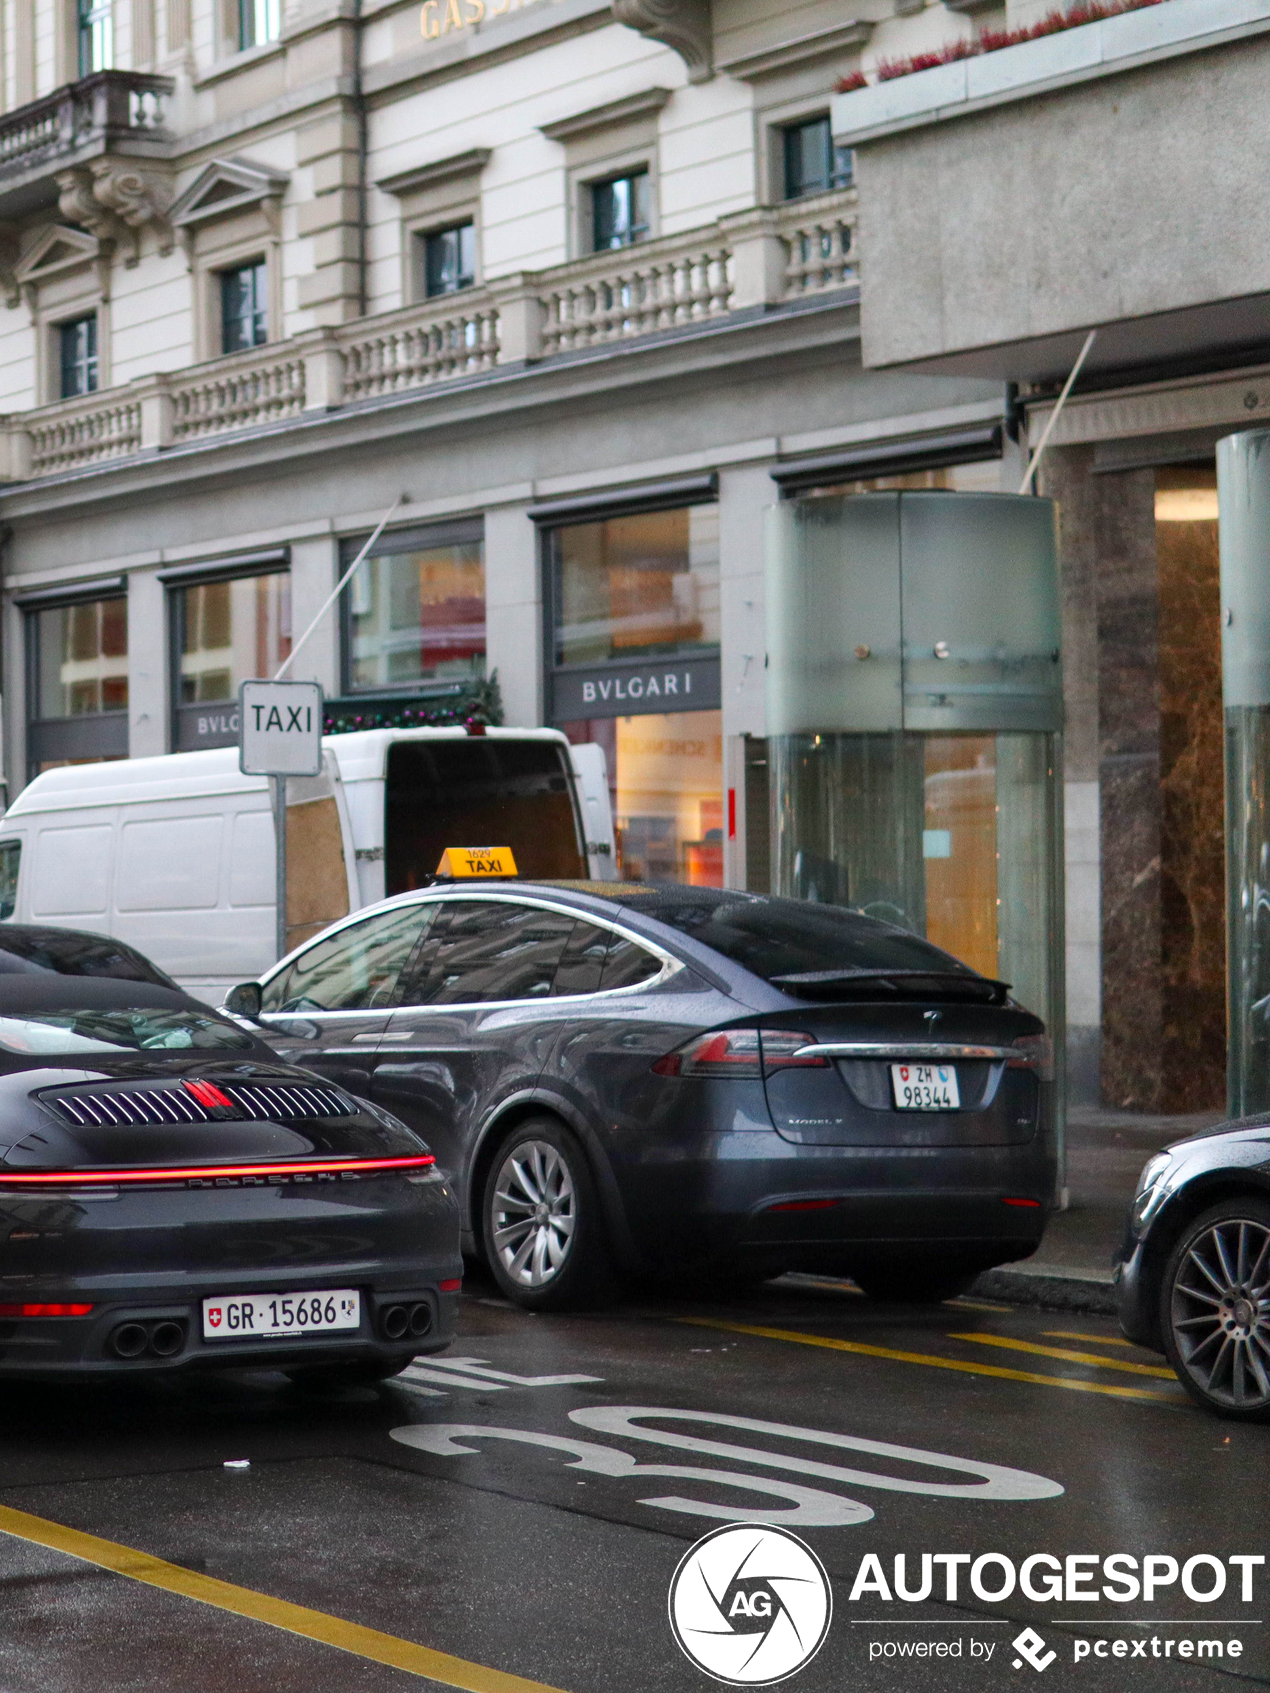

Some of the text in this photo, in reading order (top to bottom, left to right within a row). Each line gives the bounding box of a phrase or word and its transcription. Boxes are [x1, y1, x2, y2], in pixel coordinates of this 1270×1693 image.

[582, 673, 692, 702] BVLGARI
[251, 704, 312, 733] TAXI
[466, 860, 503, 873] TAXI
[917, 1067, 933, 1083] ZH
[903, 1086, 951, 1108] 98344
[389, 1405, 1065, 1526] 30
